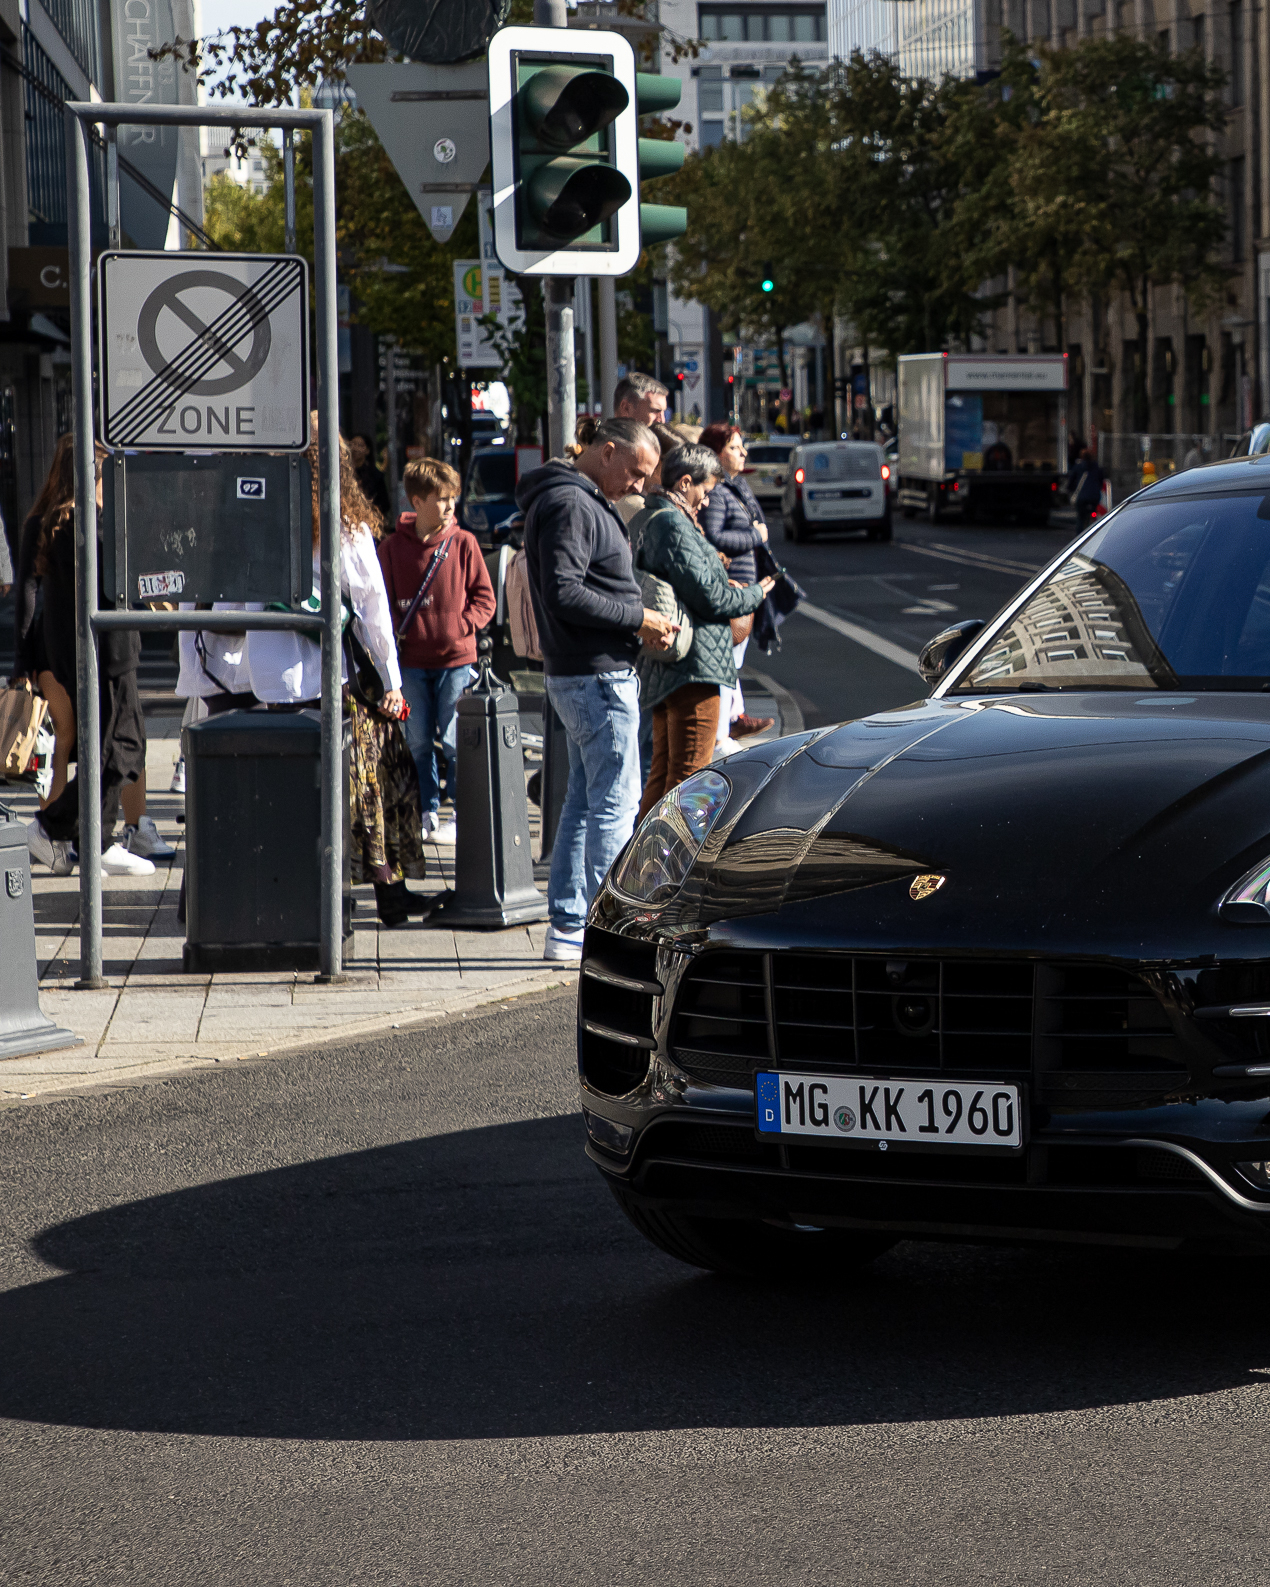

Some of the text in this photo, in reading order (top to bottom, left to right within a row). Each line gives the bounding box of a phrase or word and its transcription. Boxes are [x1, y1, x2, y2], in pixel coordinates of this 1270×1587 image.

[124, 0, 156, 146] CHAFFNR
[156, 405, 256, 436] ZONE
[765, 1109, 774, 1122] D
[783, 1080, 1015, 1137] MG KK 1960
